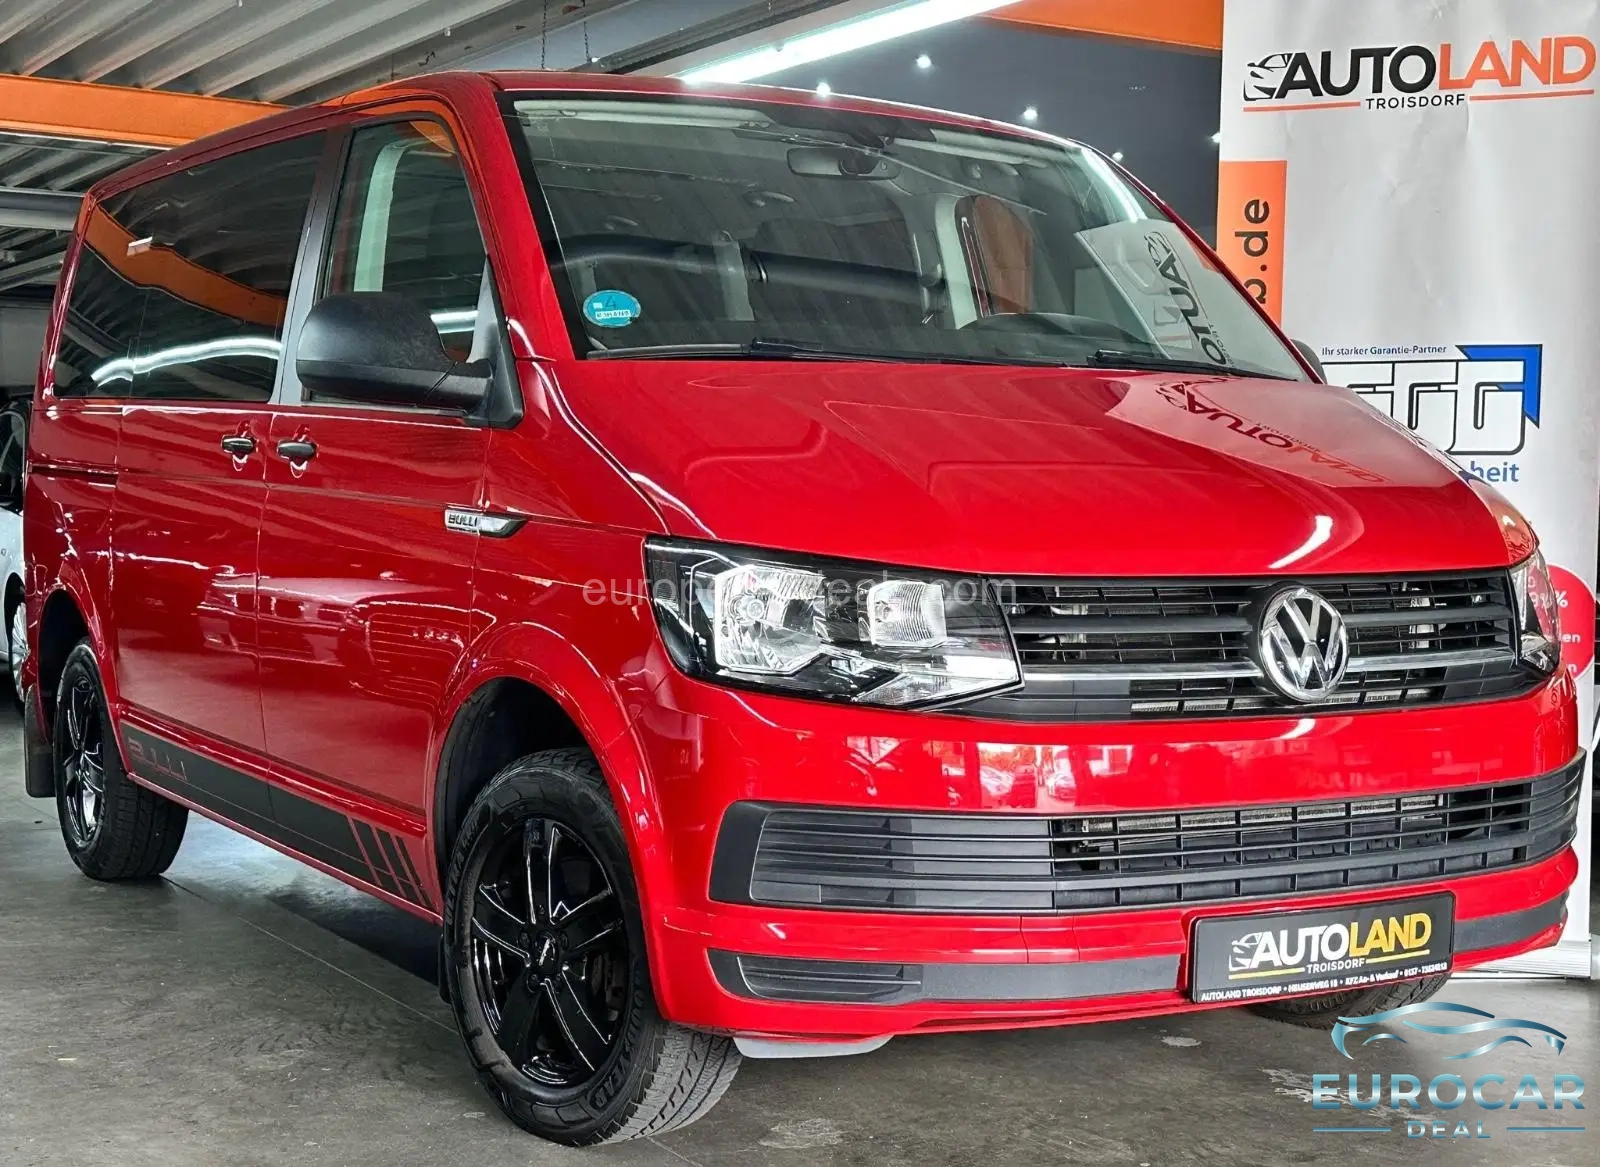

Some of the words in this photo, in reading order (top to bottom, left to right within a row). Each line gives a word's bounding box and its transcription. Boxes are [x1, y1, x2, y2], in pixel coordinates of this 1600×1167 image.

[1274, 36, 1597, 99] AUTOLAND
[1365, 93, 1466, 110] TROISDORF
[1321, 346, 1335, 356] Ihr
[1336, 346, 1368, 356] starker
[1369, 344, 1448, 356] Garantie-Partner
[448, 513, 478, 527] BULLI
[1249, 912, 1432, 969] AUTOLAND
[1306, 957, 1366, 974] TROISDORF
[1200, 989, 1242, 1002] AUTOLAND
[1242, 985, 1282, 998] TROISDORF
